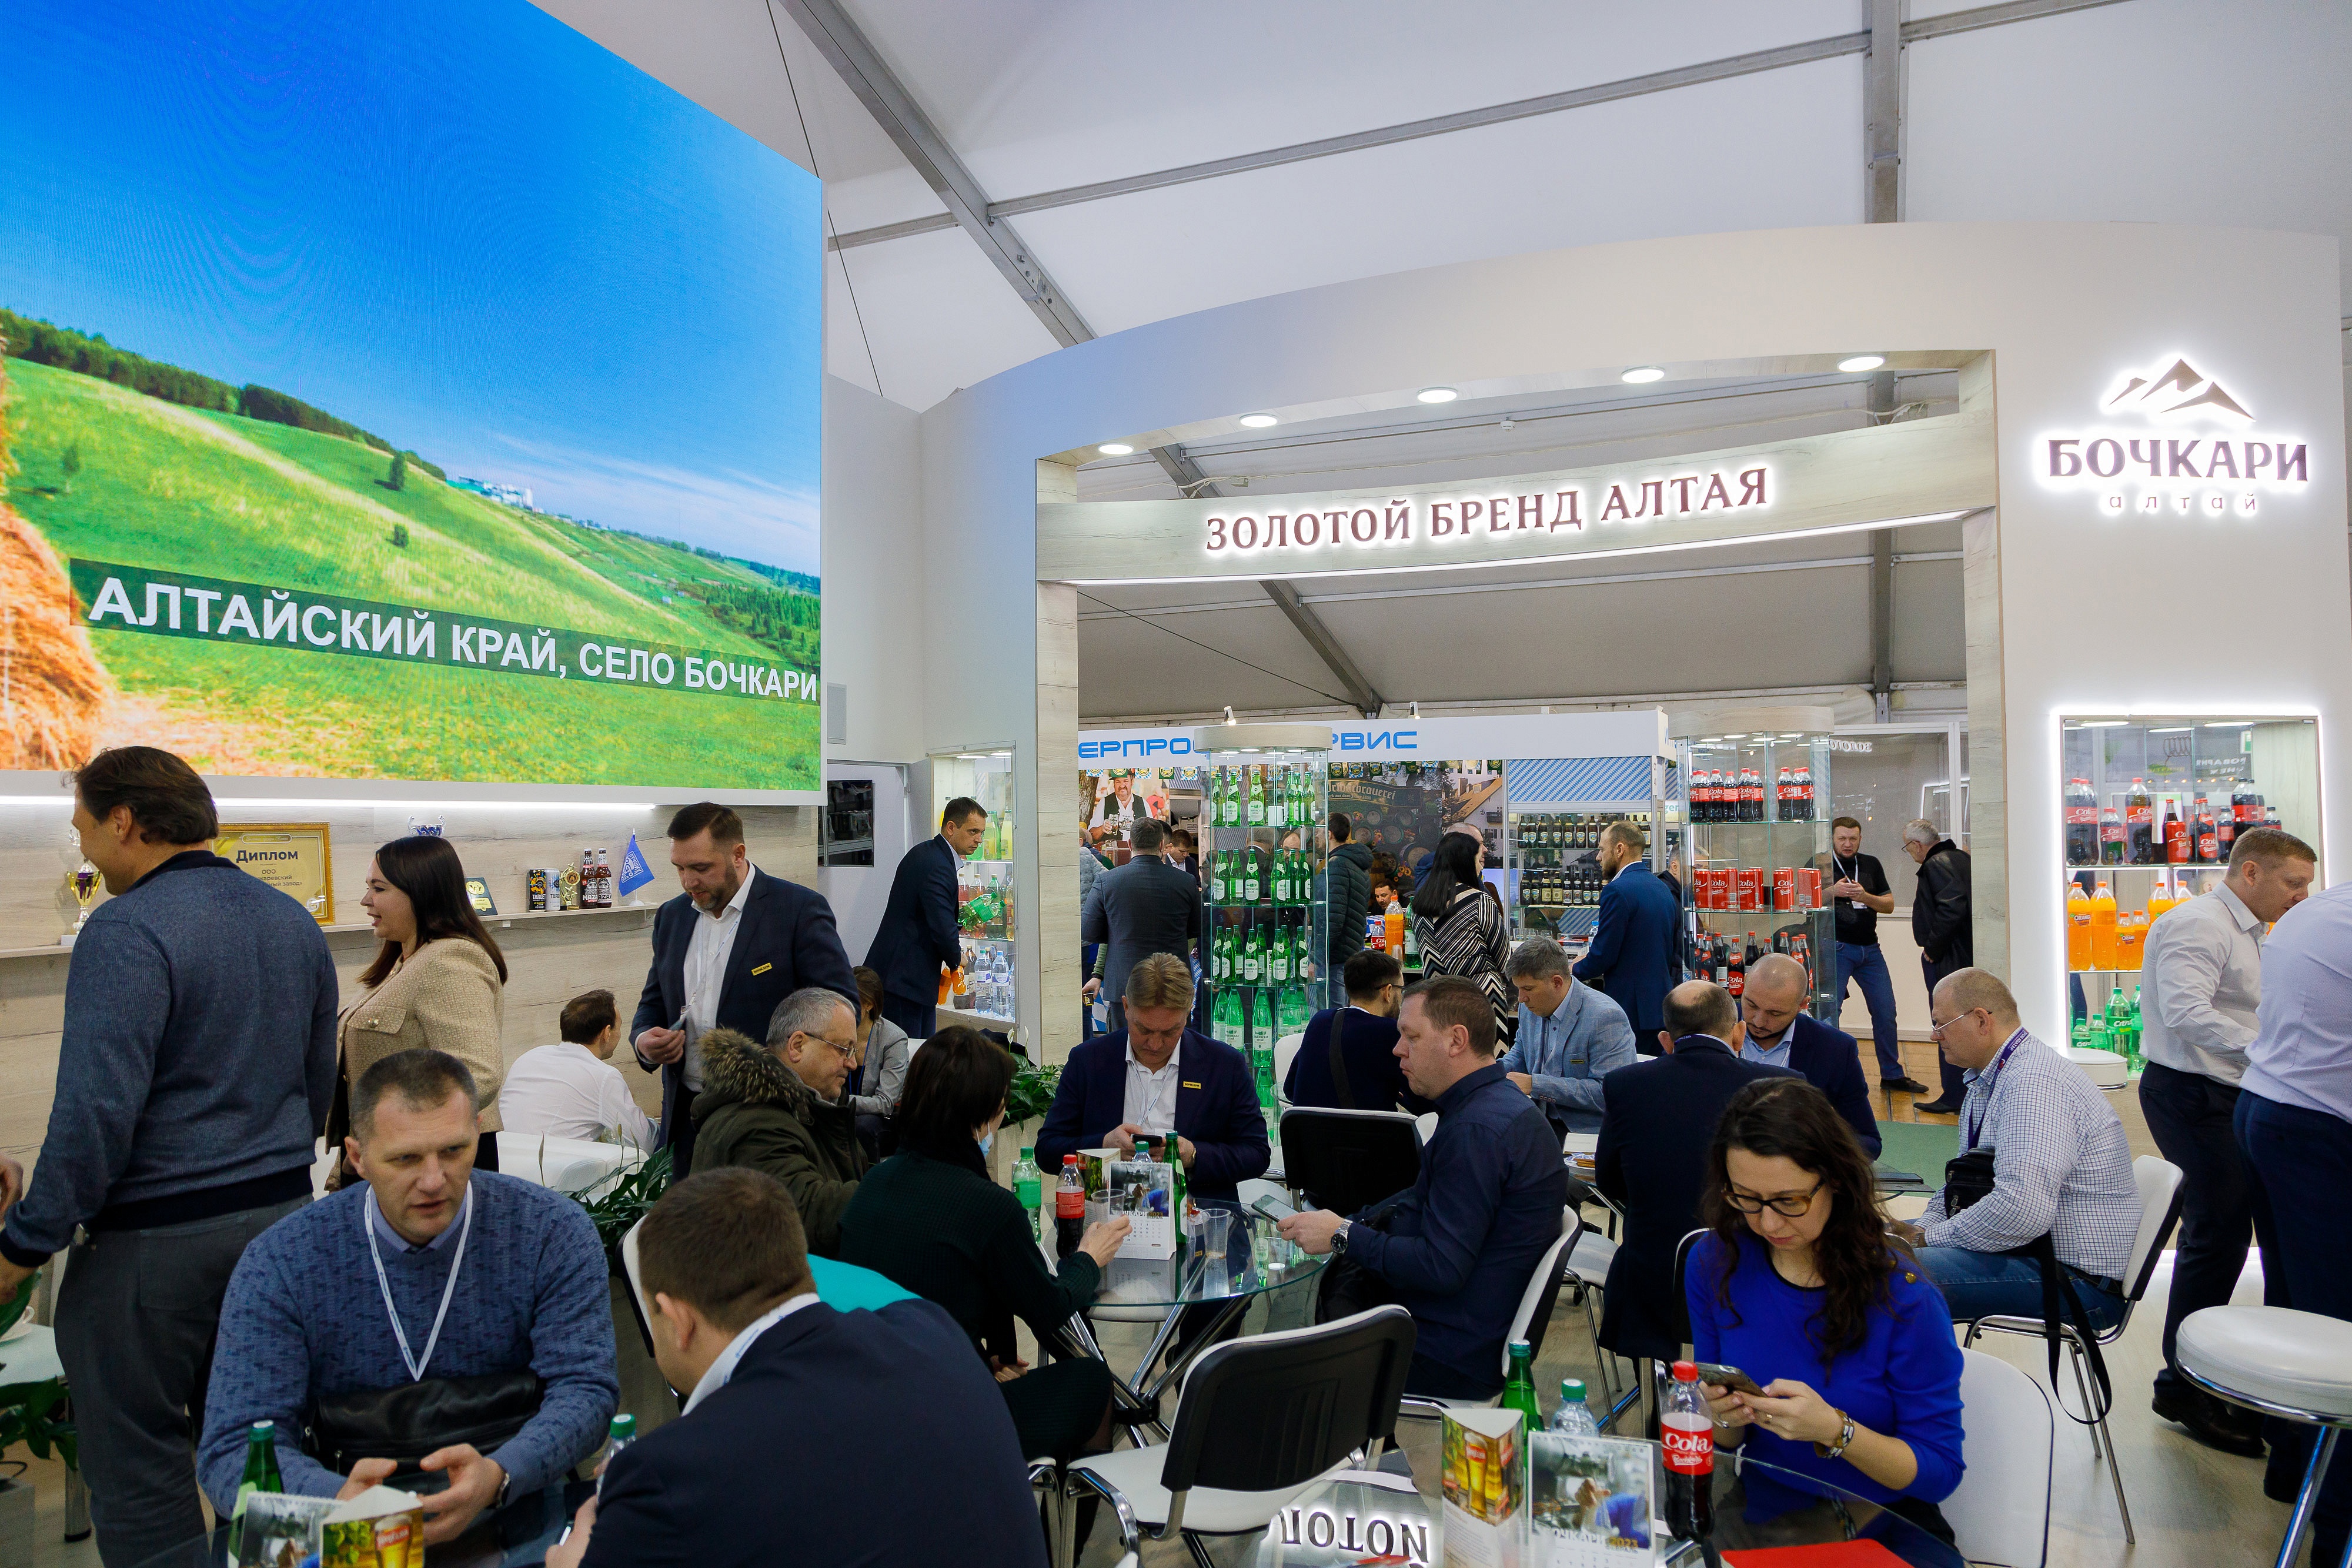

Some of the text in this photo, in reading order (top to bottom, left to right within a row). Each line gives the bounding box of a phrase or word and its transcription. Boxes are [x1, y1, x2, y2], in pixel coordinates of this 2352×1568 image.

[2048, 438, 2308, 482] БОЧКАРИ
[1207, 468, 1768, 551] ЗОЛОТОЙ БРЕНД АЛТАЯ
[2110, 493, 2256, 510] алтай
[88, 577, 817, 701] АЛТАЙСКИЙ КРАЙ, СЕЛО БОЧКАРИ
[1078, 731, 1417, 759] ЕРПРО ВИС
[236, 850, 298, 863] Диплом
[1665, 1432, 1708, 1452] Cola
